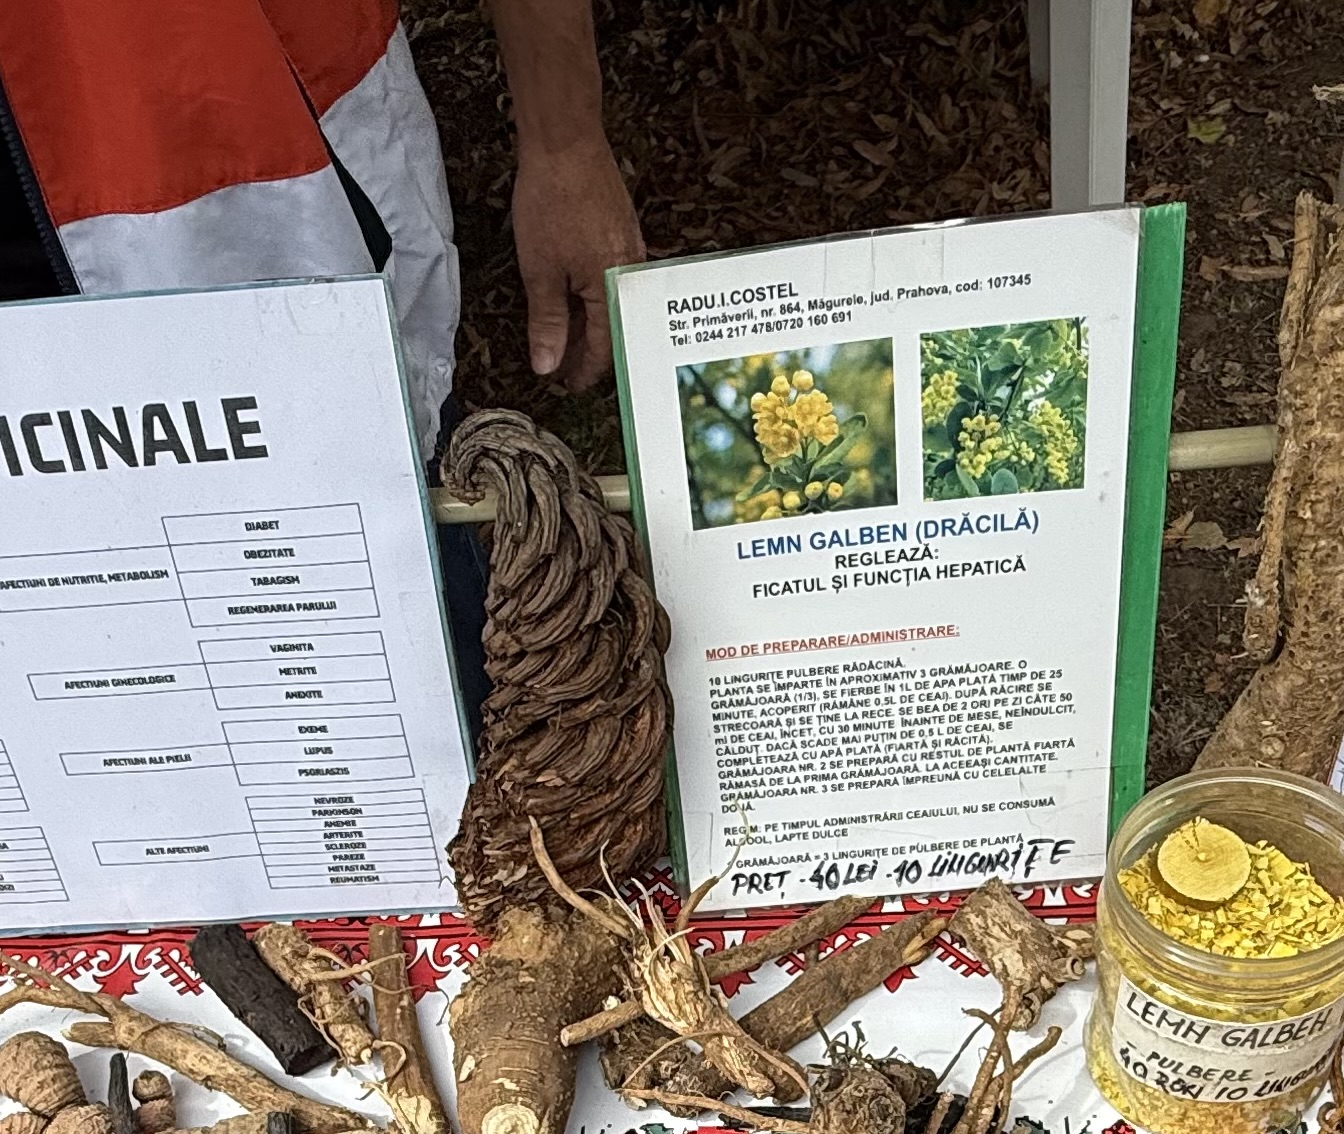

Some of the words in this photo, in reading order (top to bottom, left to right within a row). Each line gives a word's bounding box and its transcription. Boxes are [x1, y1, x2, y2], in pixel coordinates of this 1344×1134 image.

[669, 320, 689, 332] Str.
[760, 308, 776, 319] nr.
[779, 302, 805, 315] 864,
[807, 293, 868, 311] Măgurele,
[870, 289, 894, 306] jud.
[897, 284, 952, 300] Prahova,
[955, 279, 983, 293] cod:
[986, 273, 1032, 289] 107345
[670, 335, 692, 347] Tel:
[695, 331, 724, 343] 0244
[726, 325, 747, 338] 217
[751, 317, 804, 334] 478/0720
[807, 313, 829, 327] 160
[831, 310, 853, 324] 691
[245, 520, 280, 532] DIABET
[737, 534, 802, 560] LEMN
[809, 522, 908, 550] GALBEN
[916, 507, 1040, 544] (DRĂCILĂ)
[244, 547, 296, 560] OBEZITATE
[835, 543, 940, 569] REGLEAZĂ:
[108, 569, 170, 584] METABOLISM
[250, 574, 300, 587] TABAGISM
[752, 577, 827, 599] FICATUL
[936, 554, 1026, 580] HEPATICĂ
[705, 646, 737, 660] MOD
[740, 643, 759, 656] DE
[763, 625, 960, 653] PREPARARE/ADMINISTRARE:
[786, 665, 839, 678] PULBERE
[304, 745, 334, 756] LUPUS
[724, 825, 761, 836] REGM:
[765, 823, 779, 832] PE
[781, 820, 820, 831] TIMPUL
[962, 804, 979, 814] NU
[981, 802, 996, 813] SE
[775, 832, 809, 843] LAPTE
[812, 828, 849, 839] DULCE
[909, 840, 959, 853] PULBERE
[962, 838, 978, 848] DE
[1145, 1050, 1254, 1083] PULBERE
[1214, 1086, 1248, 1100] 10
